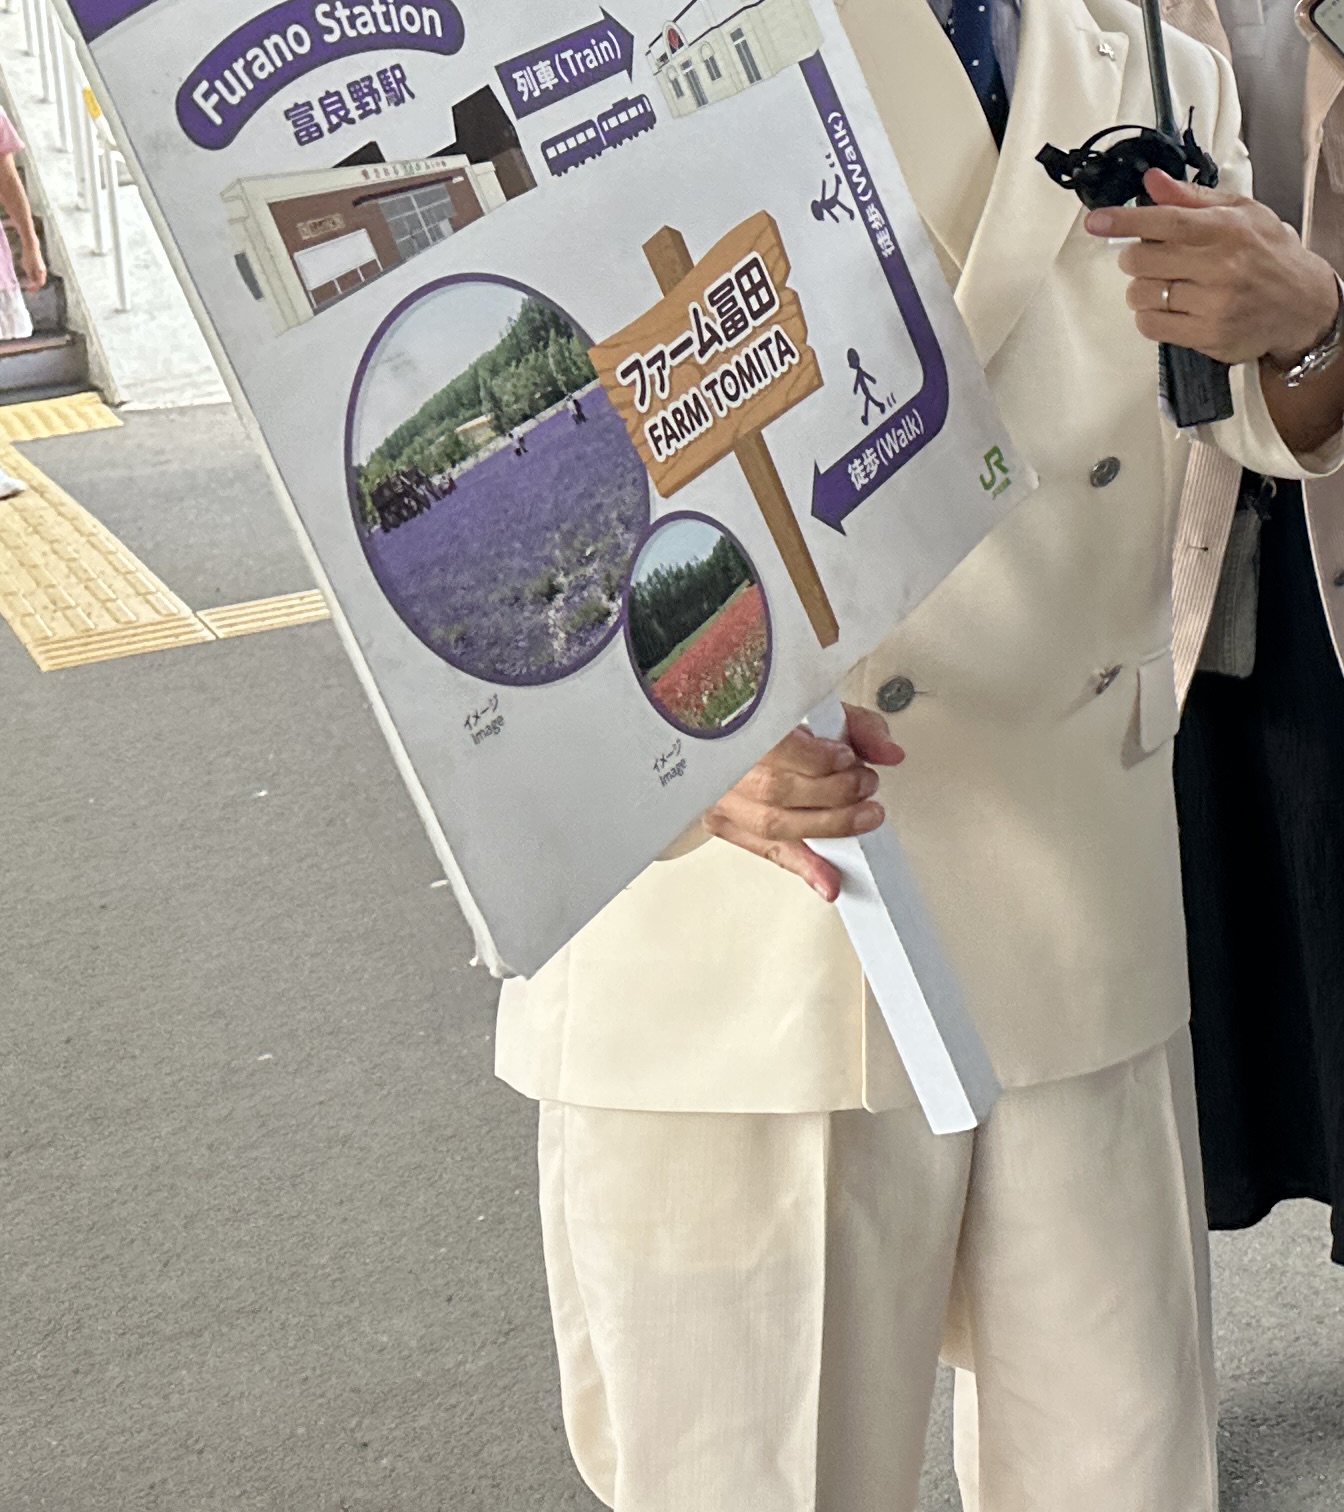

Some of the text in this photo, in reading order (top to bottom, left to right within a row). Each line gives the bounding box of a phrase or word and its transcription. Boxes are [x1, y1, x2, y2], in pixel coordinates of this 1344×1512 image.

[191, 21, 312, 127] Furano
[283, 62, 416, 147] 富良野駅
[618, 255, 778, 410] ファーム富田
[647, 329, 798, 459] FARM TOMITA
[979, 445, 1009, 491] JR
[462, 693, 500, 731] イメージ
